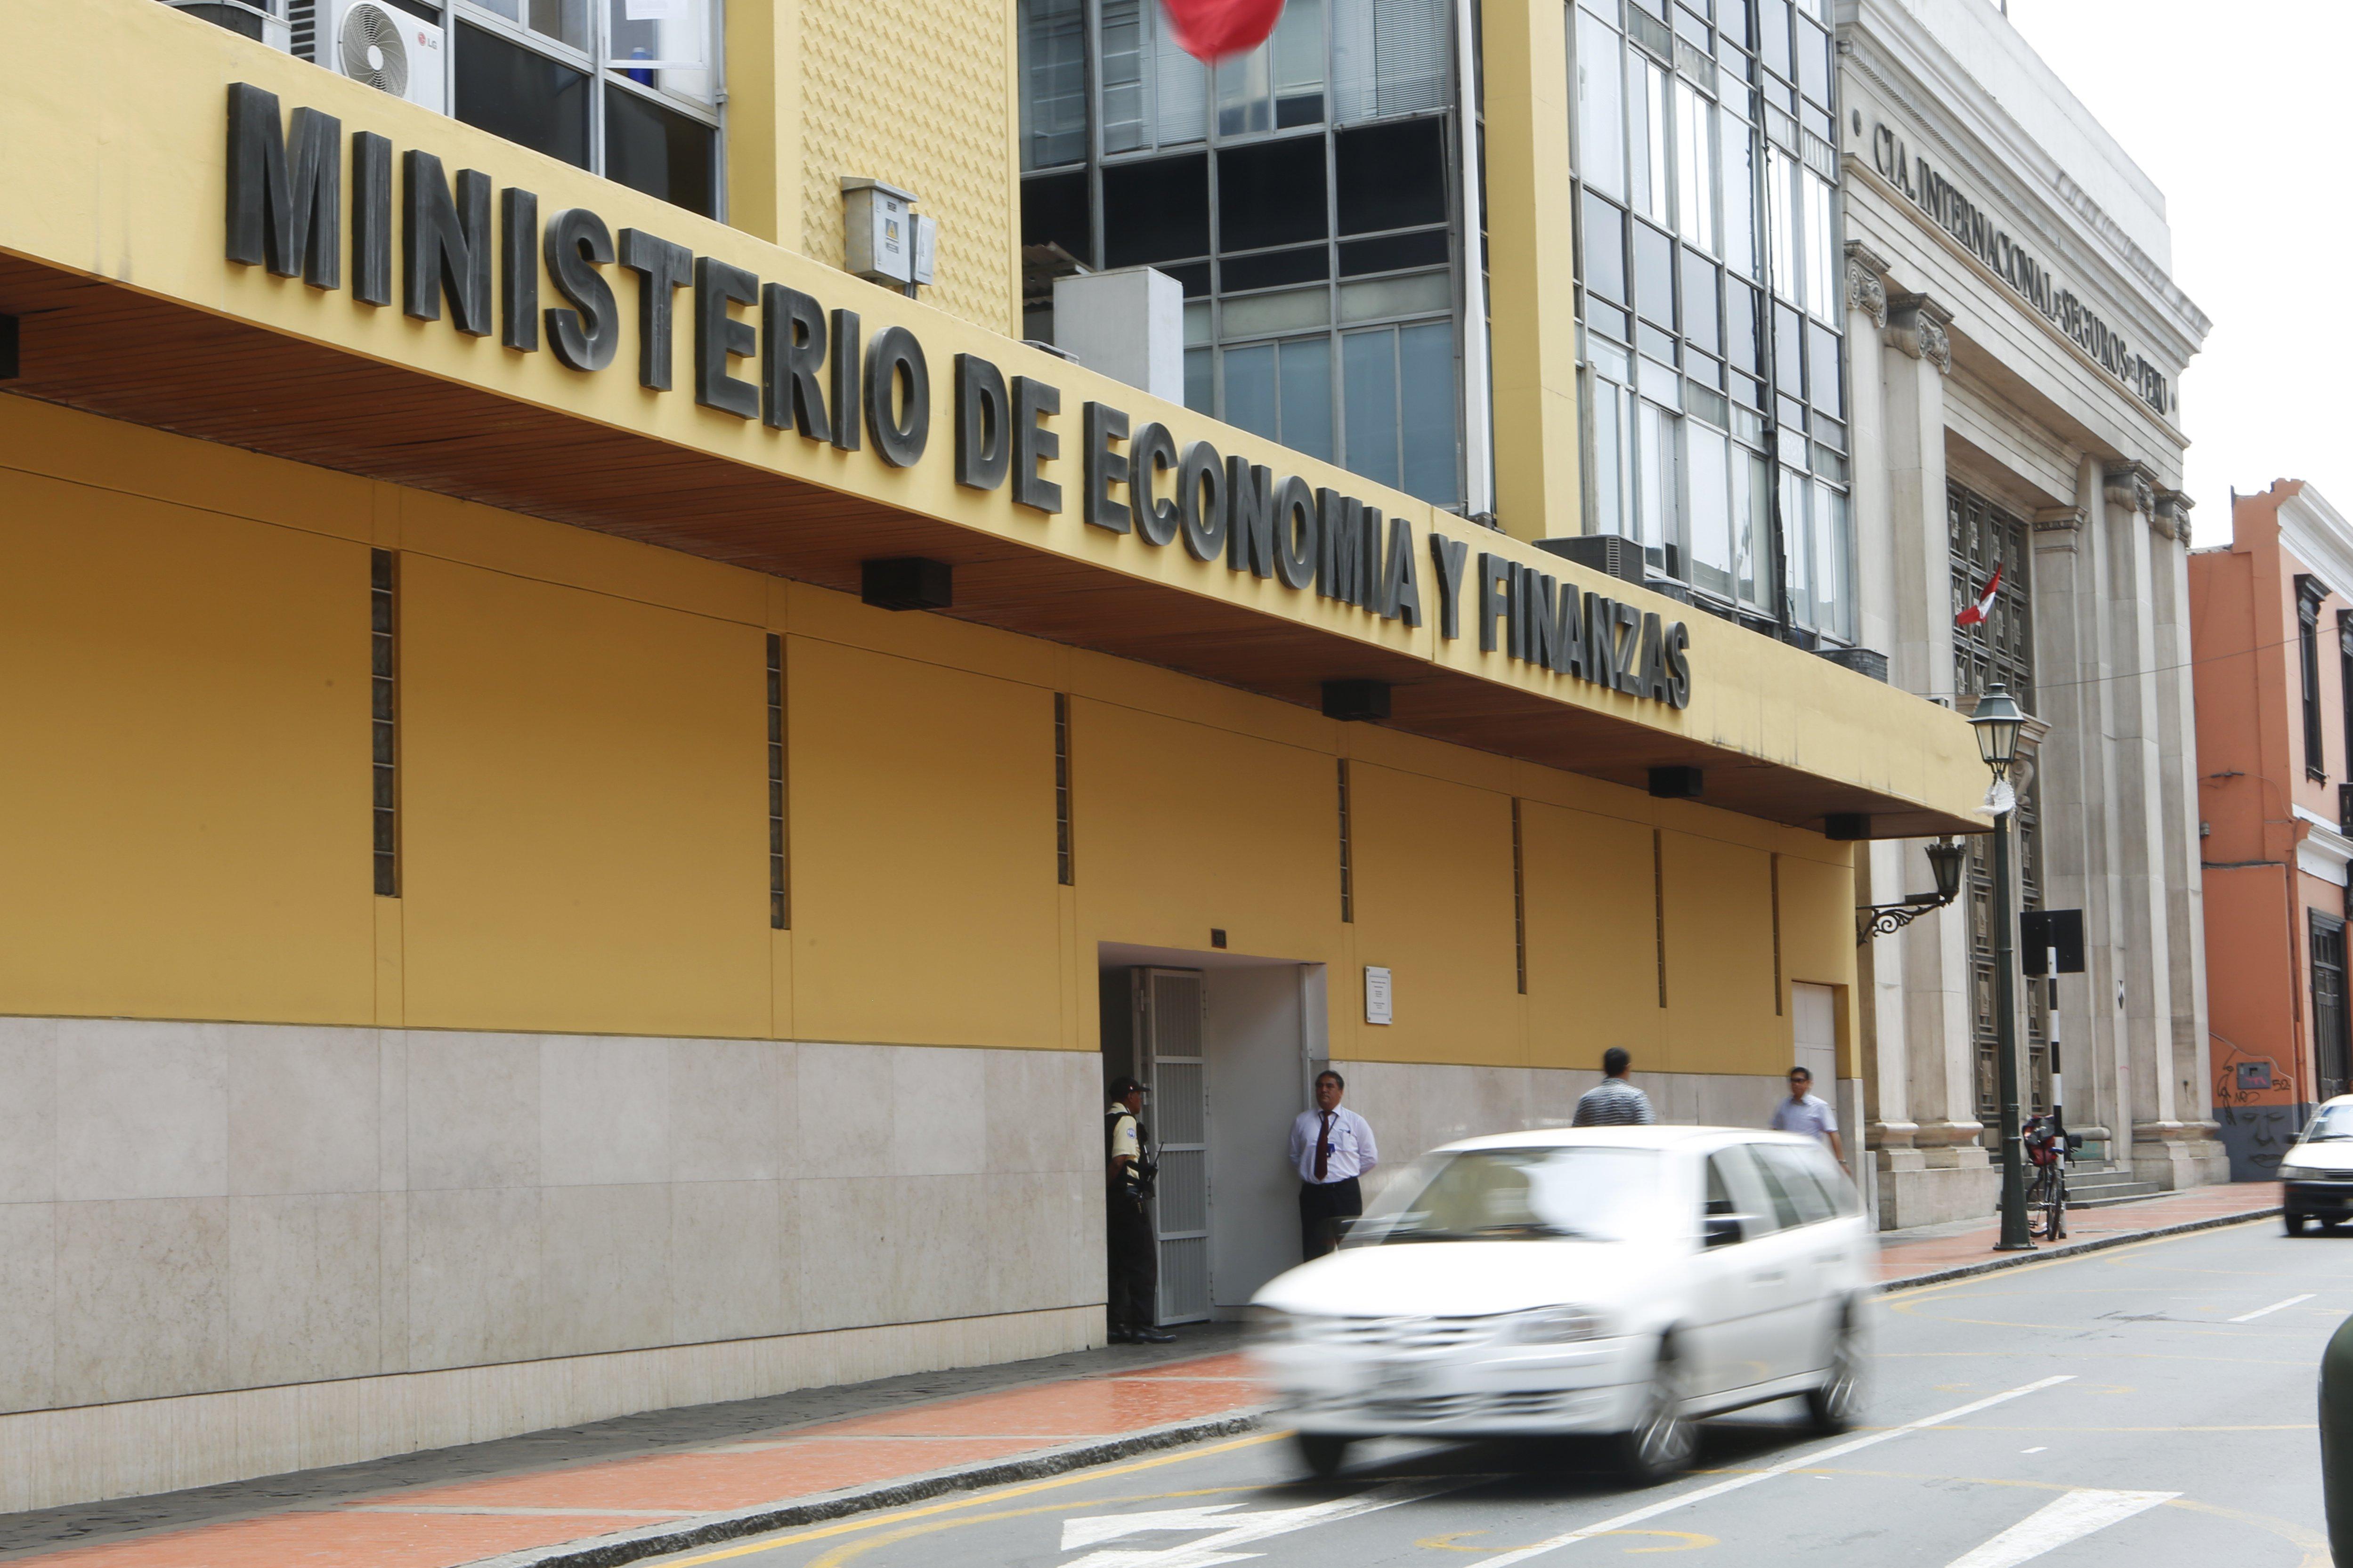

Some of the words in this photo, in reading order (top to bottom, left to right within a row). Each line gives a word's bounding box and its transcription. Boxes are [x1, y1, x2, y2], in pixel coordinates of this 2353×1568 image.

[427, 38, 437, 50] LG
[1917, 157, 2055, 322] INTERNACIONAL
[2062, 289, 2126, 381] SEGUROS
[226, 81, 930, 468] MINISTERIO
[955, 353, 1062, 515] DE
[1083, 401, 1421, 628] ECONOMIA
[1430, 533, 1469, 639] Y
[1479, 552, 1690, 710] FINANZAS
